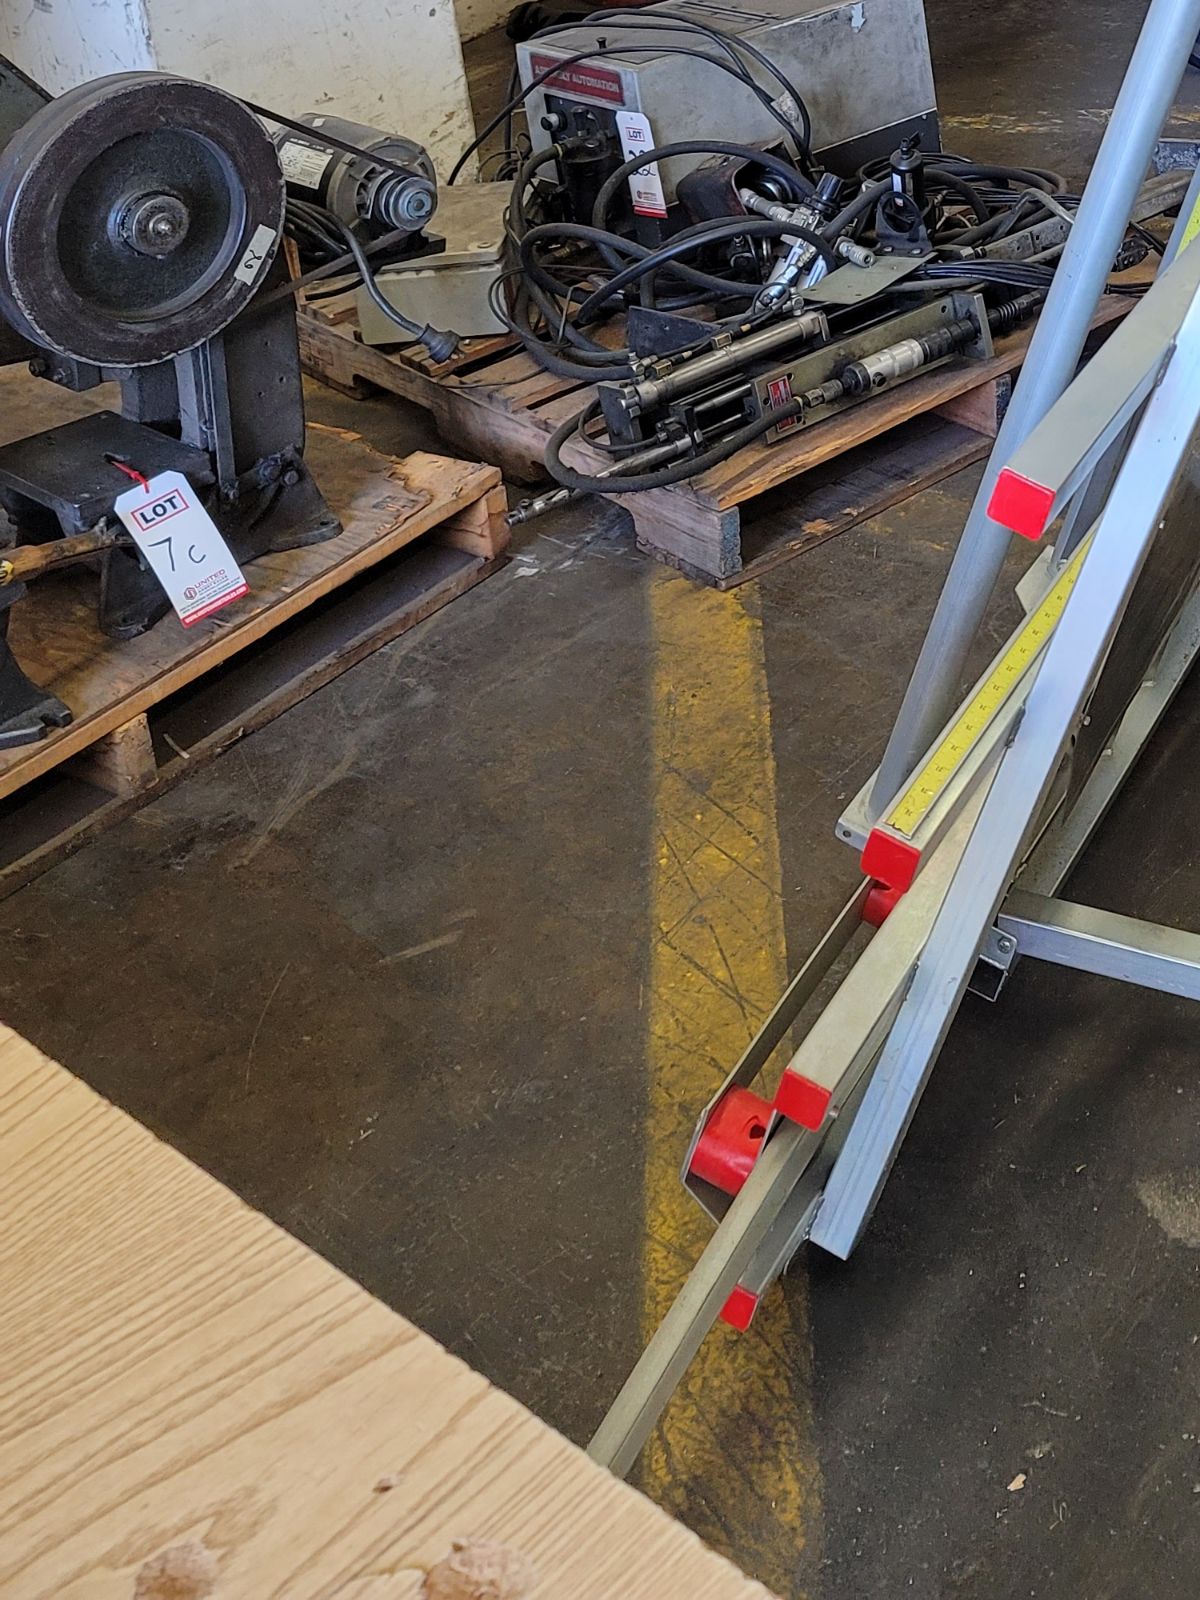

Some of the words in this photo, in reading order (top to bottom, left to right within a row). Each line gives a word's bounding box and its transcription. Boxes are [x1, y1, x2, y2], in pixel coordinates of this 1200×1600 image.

[628, 130, 642, 139] LOT
[140, 495, 178, 524] LOT
[194, 568, 226, 589] UNITED
